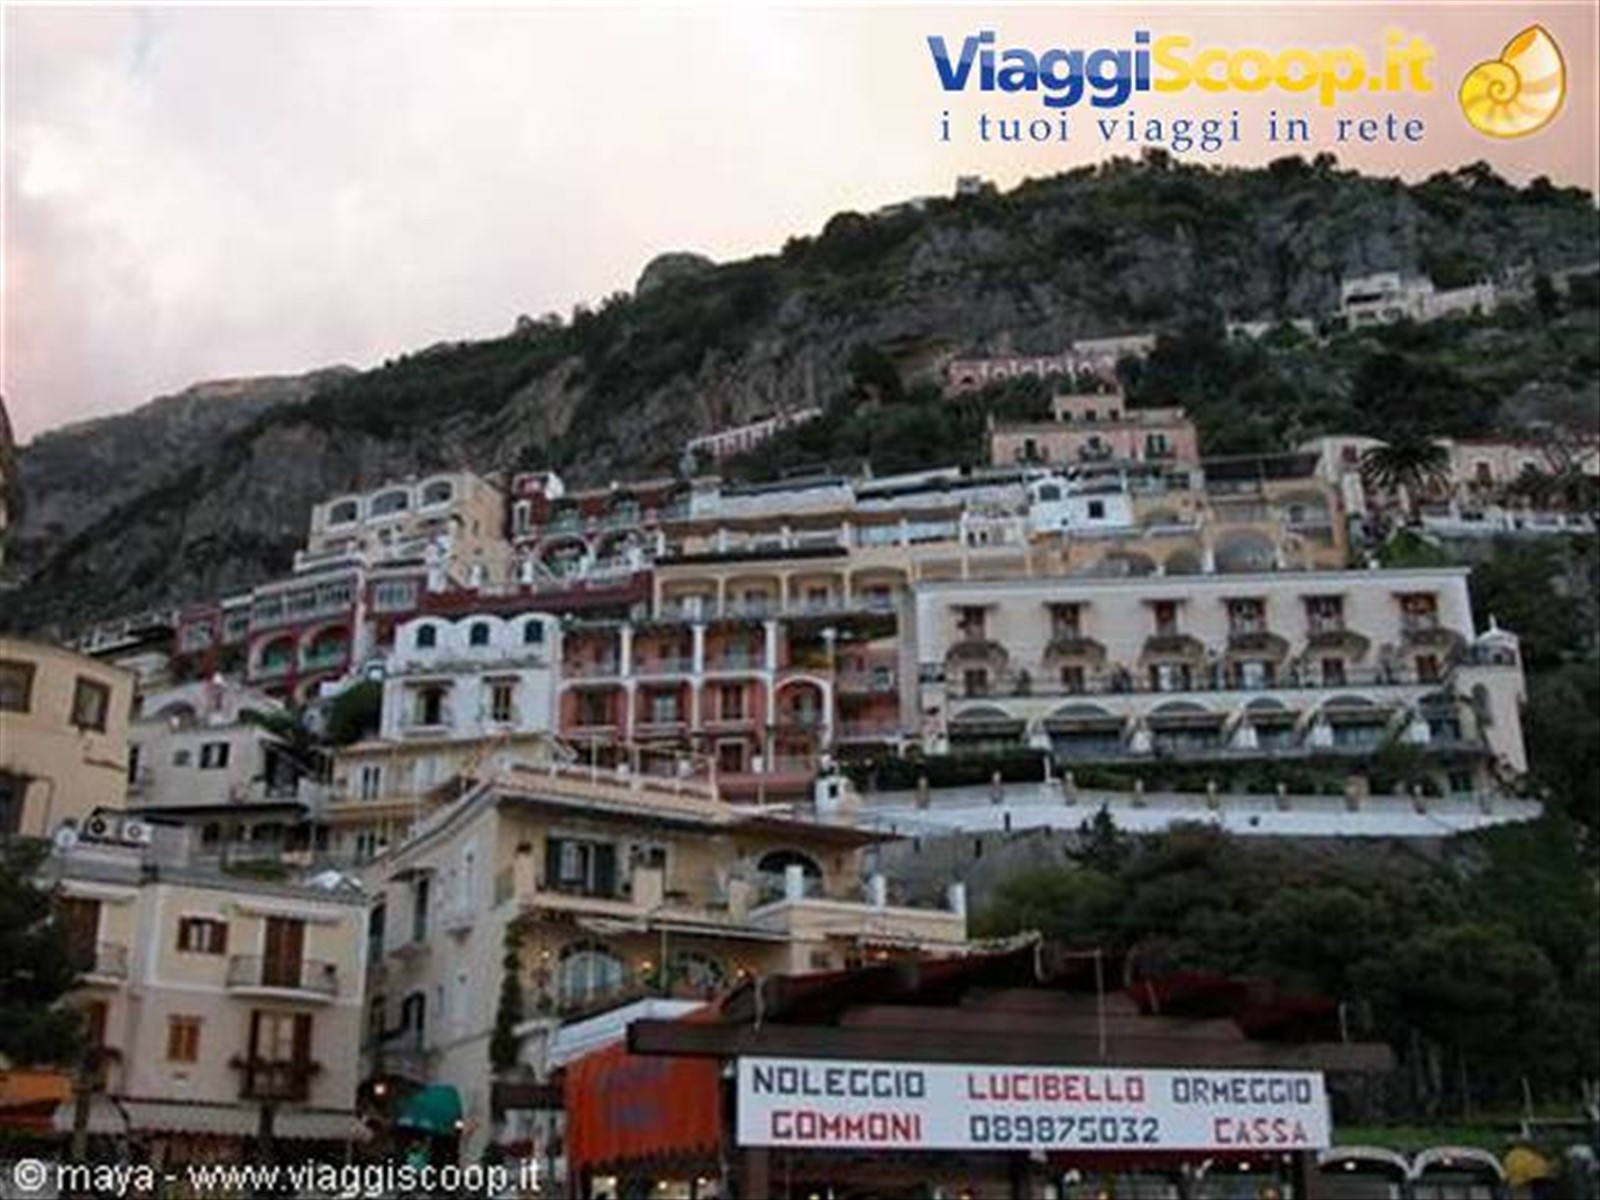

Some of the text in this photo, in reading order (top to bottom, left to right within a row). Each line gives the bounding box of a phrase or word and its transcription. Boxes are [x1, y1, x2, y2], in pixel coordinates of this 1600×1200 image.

[753, 1066, 1311, 1106] NOLEGGIO LUCIBELLO ORMEGGIO
[771, 1111, 1308, 1143] GOMMONI 089875032 CASSA
